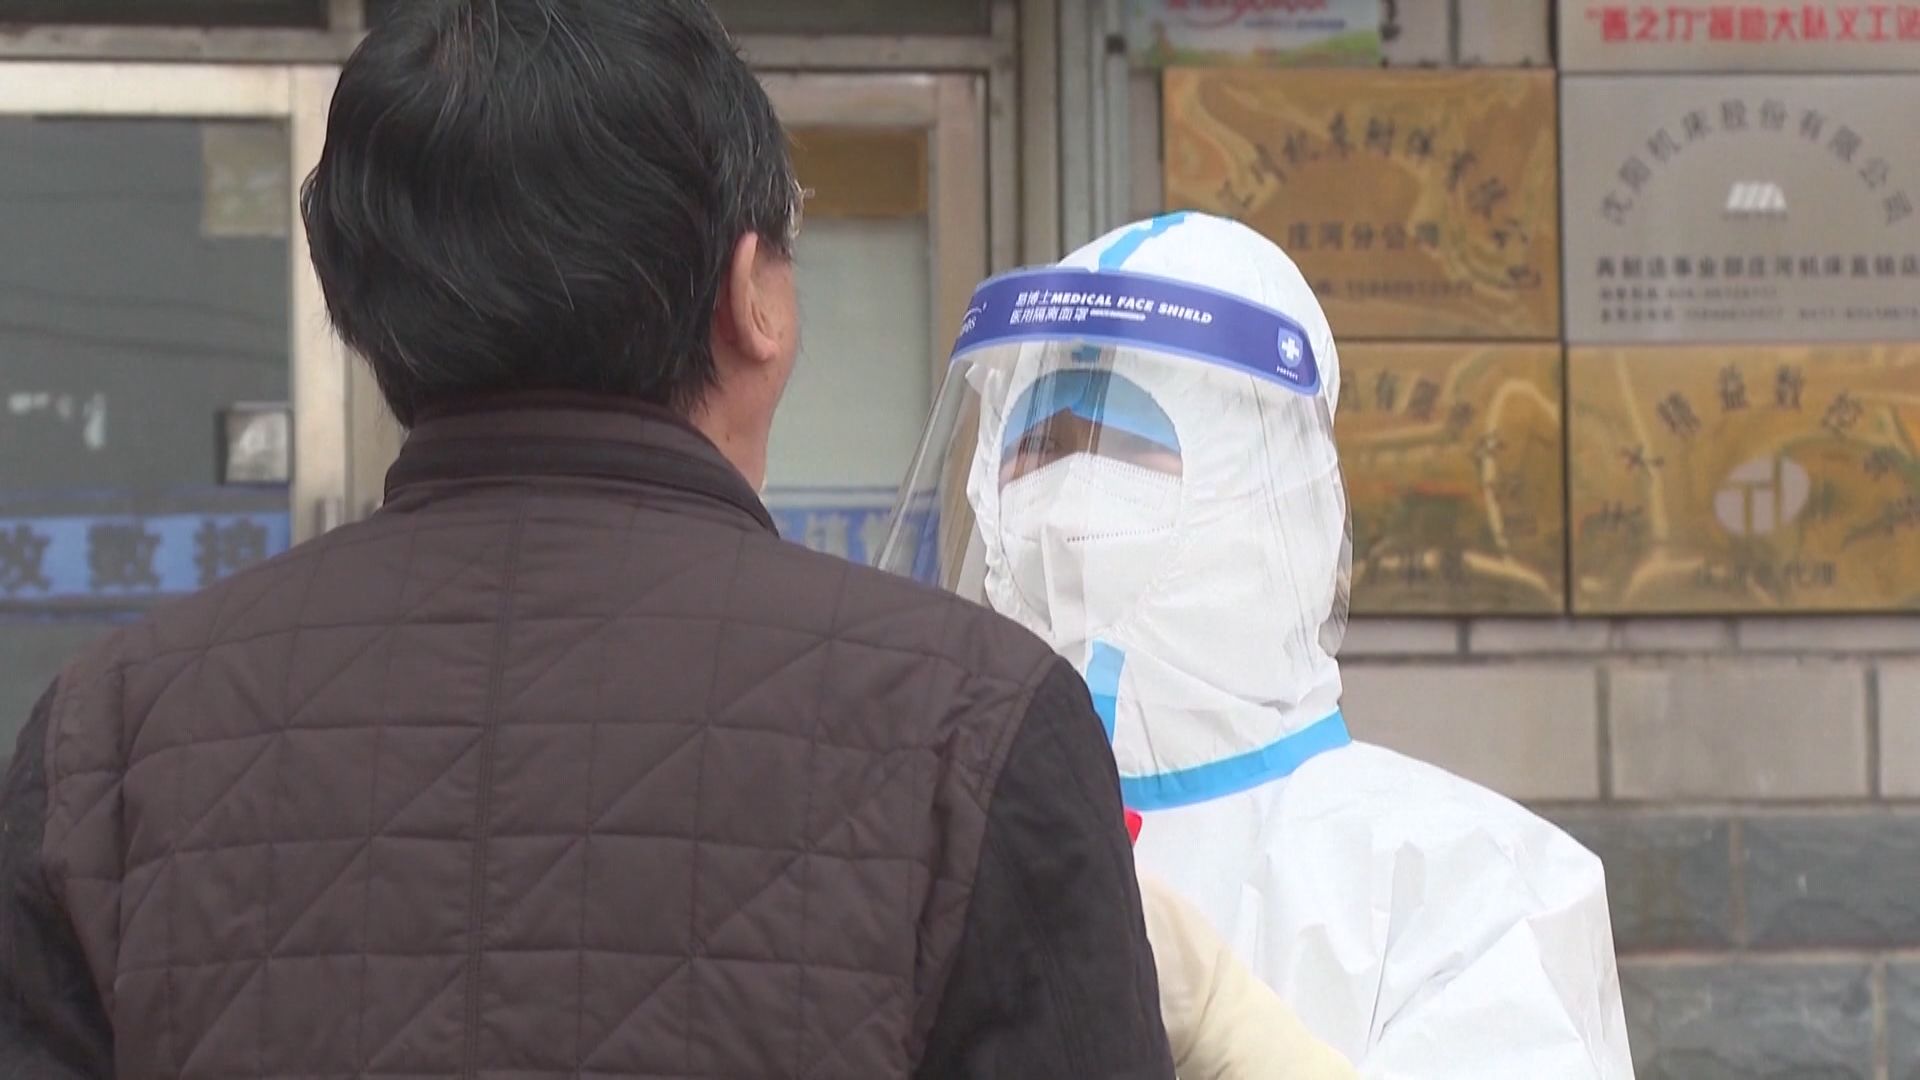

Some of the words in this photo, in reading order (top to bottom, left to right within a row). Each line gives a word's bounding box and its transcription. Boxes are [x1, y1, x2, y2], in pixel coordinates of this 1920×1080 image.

[1601, 98, 1913, 227] 沈阳机床股份有限公司
[1050, 291, 1112, 306] MEDICAL
[1116, 295, 1155, 312] FACE
[1158, 302, 1213, 324] SHIELD
